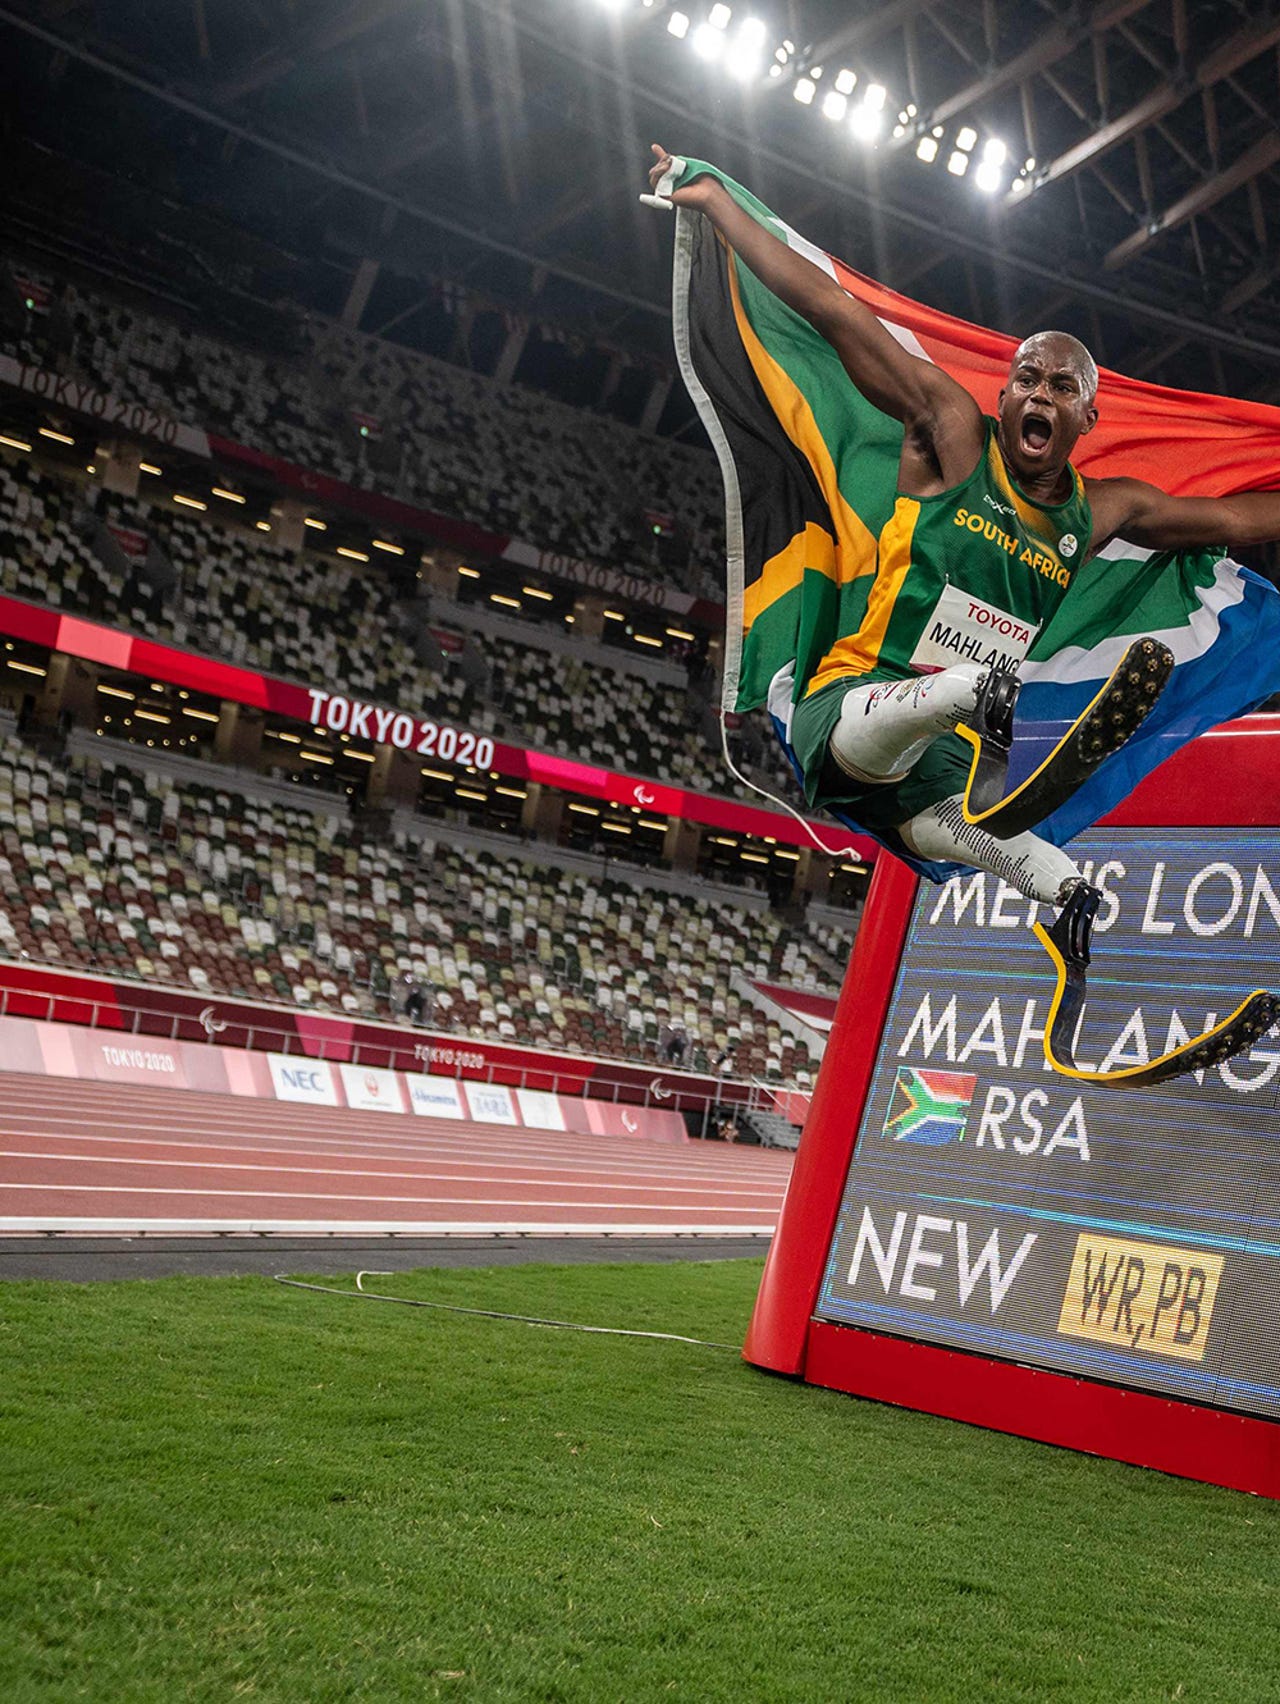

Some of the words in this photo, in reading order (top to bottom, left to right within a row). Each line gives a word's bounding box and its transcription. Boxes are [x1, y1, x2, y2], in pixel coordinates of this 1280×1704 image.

[18, 362, 106, 417] TOKYO
[113, 400, 177, 445] 2020
[953, 508, 1019, 555] SOUTH
[537, 551, 608, 589] TOKYO
[614, 571, 666, 607] 2020
[967, 602, 1030, 644] TOYOTA
[308, 688, 414, 749] TOKYO
[416, 721, 495, 770] 2020
[102, 1046, 145, 1069] TOKYO
[145, 1051, 176, 1073] 2020
[281, 1068, 325, 1092] NEC
[414, 1044, 454, 1065] TOKYO
[454, 1049, 485, 1069] 2020
[975, 1086, 1091, 1161] RSA
[847, 1205, 1038, 1315] NEW
[1081, 1249, 1207, 1348] WR,PB
